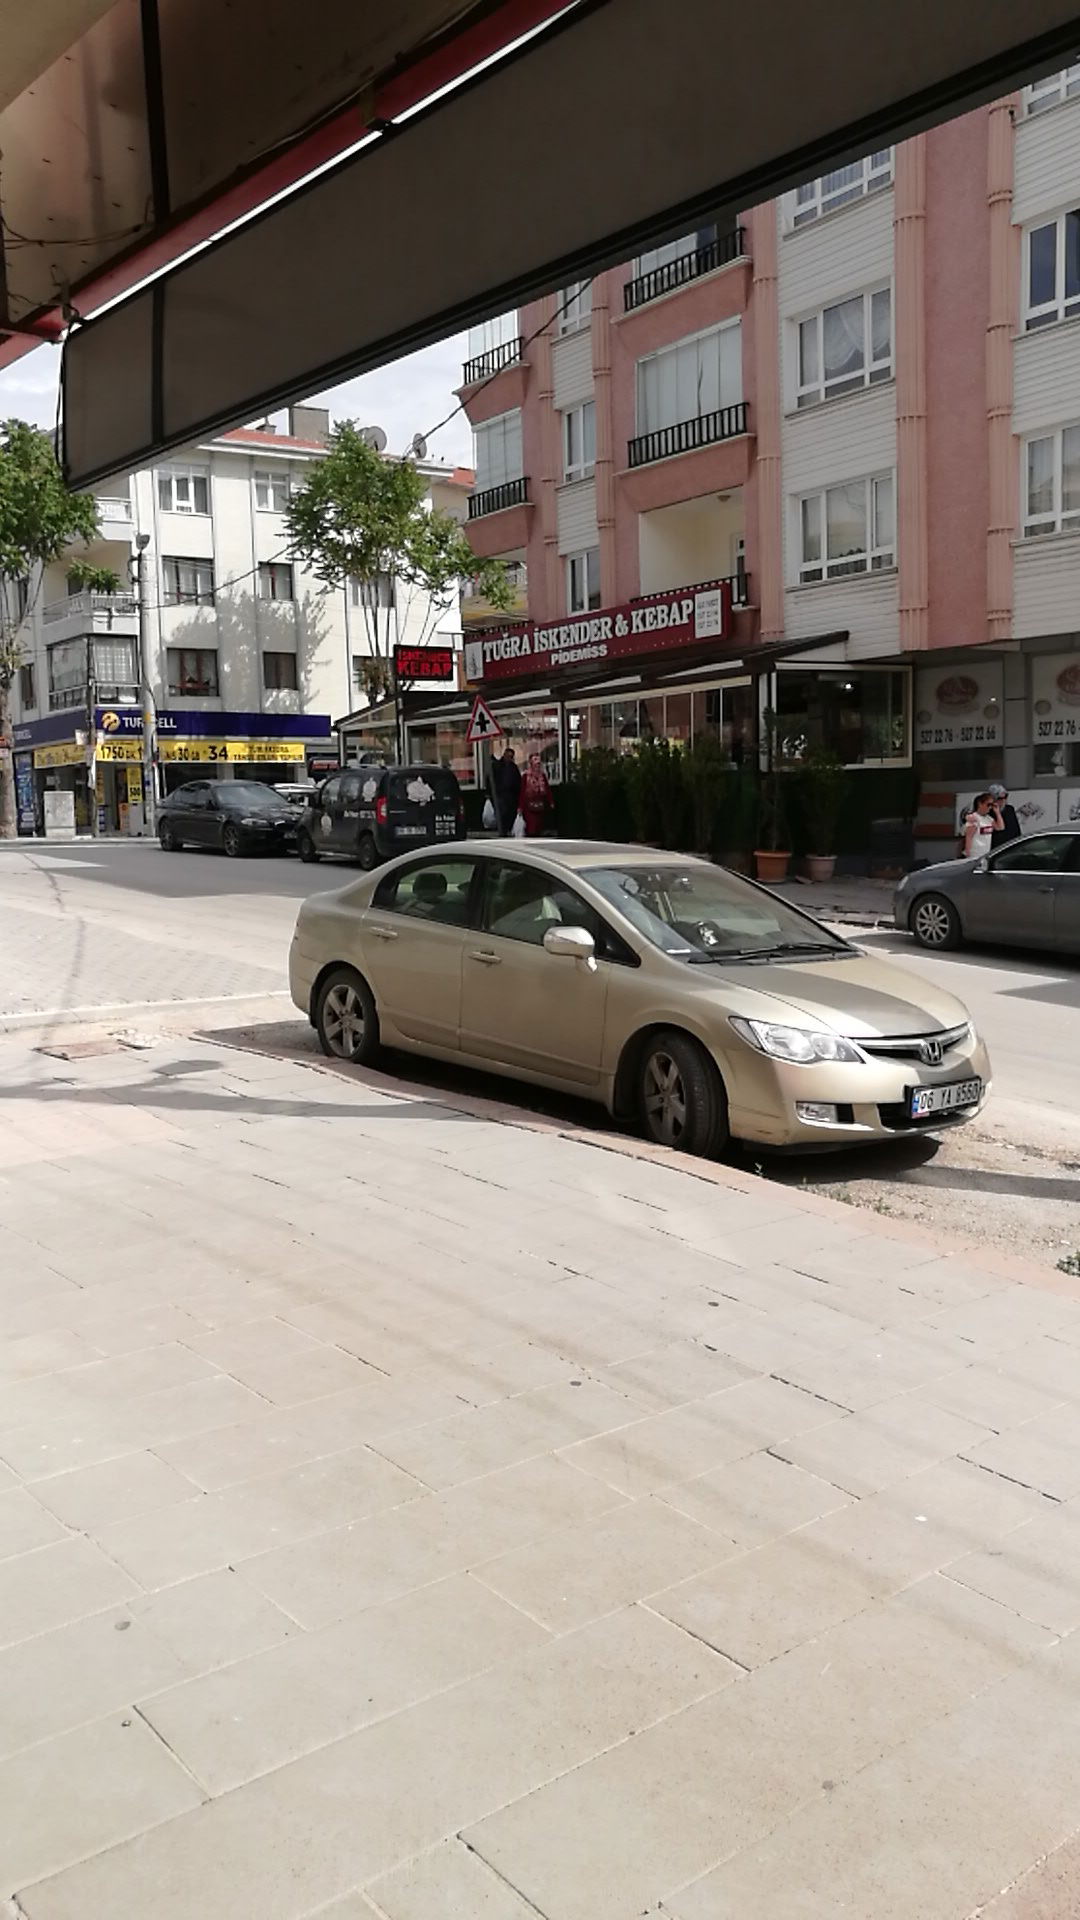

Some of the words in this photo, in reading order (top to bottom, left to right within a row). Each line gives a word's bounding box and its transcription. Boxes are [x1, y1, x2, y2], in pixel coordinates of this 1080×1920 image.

[483, 633, 531, 663] TUĞRA
[534, 616, 613, 653] İSKENDER
[615, 613, 629, 638] &
[631, 599, 694, 634] KEBAP
[550, 643, 608, 666] PİDEMİSS
[397, 661, 452, 677] KEBAP
[1038, 721, 1053, 737] 527
[1054, 720, 1064, 736] 22
[1065, 720, 1076, 735] 76
[101, 746, 125, 759] 1750
[208, 745, 229, 760] 34
[920, 1091, 934, 1110] 06
[941, 1088, 952, 1108] YA
